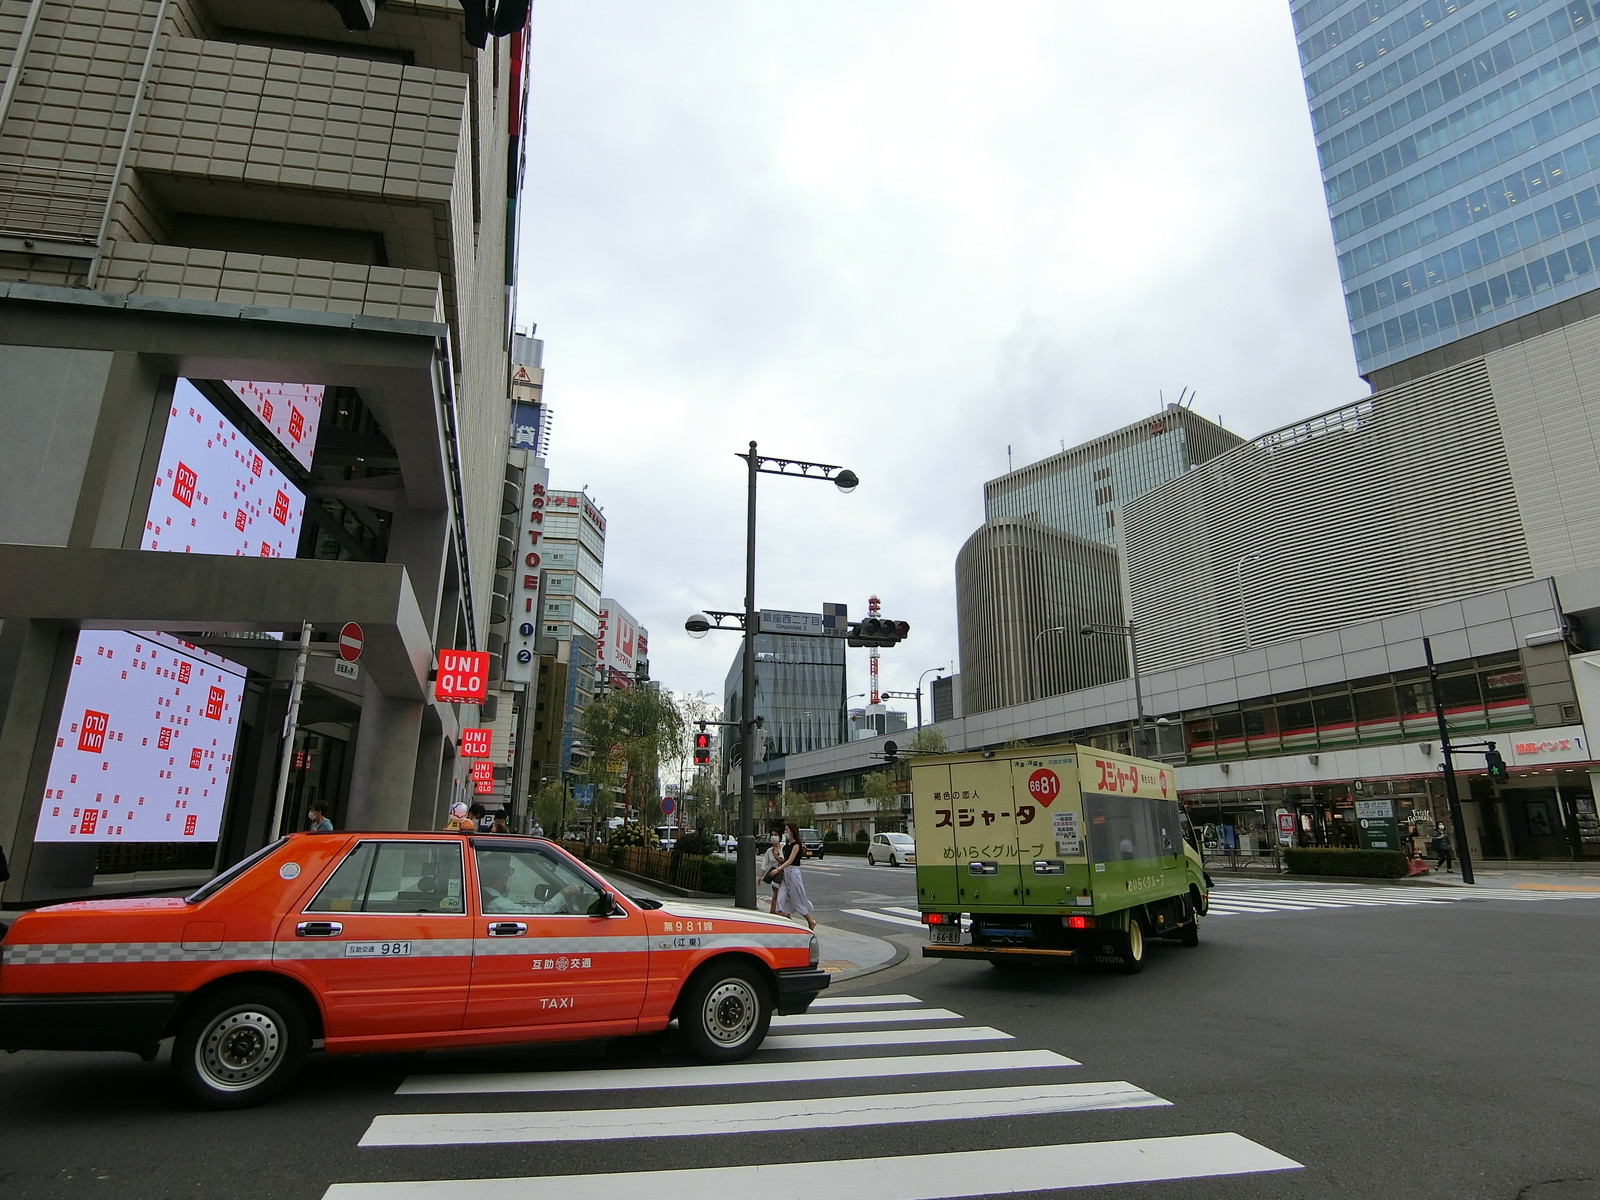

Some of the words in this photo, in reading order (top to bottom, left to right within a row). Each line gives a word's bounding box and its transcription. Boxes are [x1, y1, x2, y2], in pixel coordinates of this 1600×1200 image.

[178, 468, 195, 487] QLO
[176, 484, 192, 503] UNI
[763, 612, 820, 626] 銀座西二丁目
[444, 656, 480, 672] UNI
[442, 674, 480, 693] QLO
[86, 715, 105, 731] QLO
[82, 732, 102, 748] UNI
[465, 732, 486, 742] UNI
[464, 742, 486, 754] QLO
[1515, 739, 1570, 754] 銀座インズ
[1095, 760, 1138, 794] スジャータ
[1030, 776, 1056, 794] 6681
[934, 790, 980, 800] 褐色の恋人
[936, 806, 1036, 828] スジャータ
[943, 843, 1044, 859] めいらくグループ
[664, 920, 713, 932] 無981線
[382, 942, 408, 954] 981
[674, 938, 700, 947] (江東)
[1094, 956, 1124, 964] TOYOTA
[540, 997, 574, 1010] TAXI
